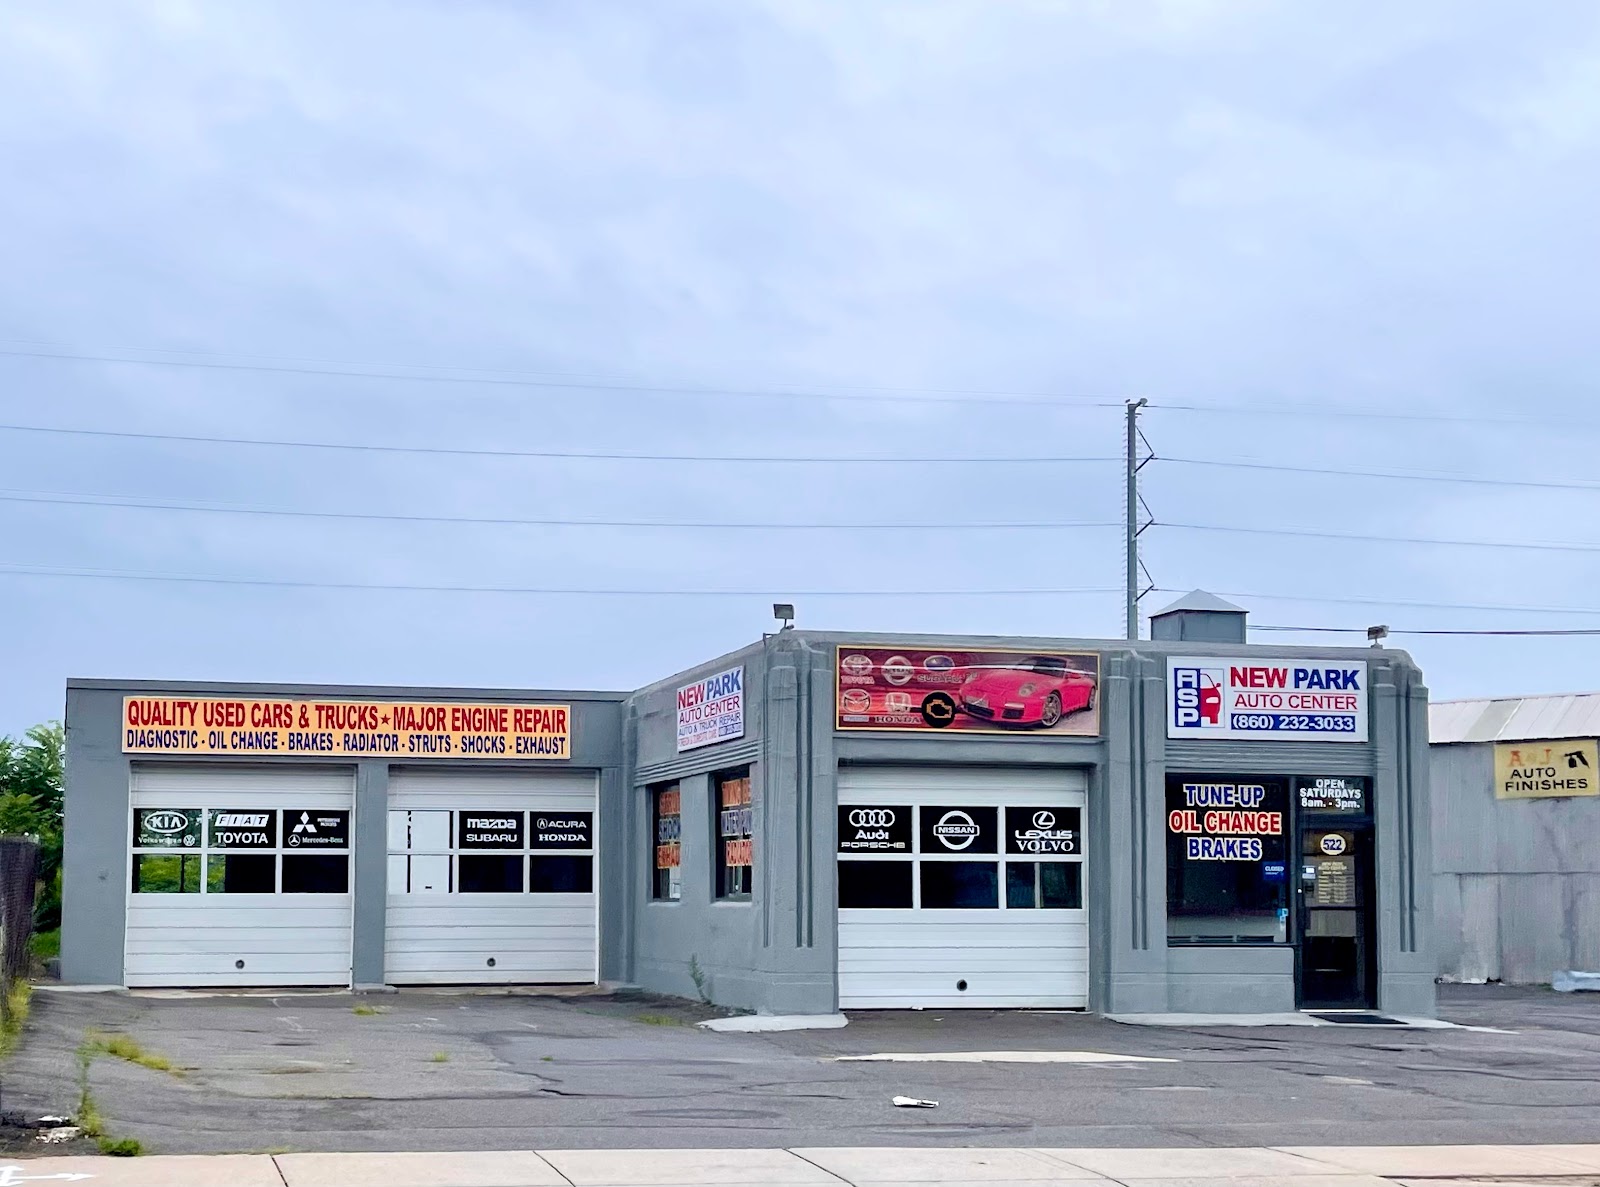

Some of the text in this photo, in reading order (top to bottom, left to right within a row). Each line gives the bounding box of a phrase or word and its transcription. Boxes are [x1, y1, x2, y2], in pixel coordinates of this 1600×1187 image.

[1230, 666, 1361, 690] NEW PARK
[678, 670, 741, 709] NEW PARK
[1234, 693, 1357, 710] AUTO CENTER
[680, 696, 740, 724] AUTO CENTER
[128, 700, 567, 734] QUALITY USED CARS & TRUCKS MAJOR ENGINE REPAIR
[719, 712, 741, 725] REPAIR
[1233, 714, 1354, 731] (860) 232-3033
[127, 729, 565, 755] DIAGNOSTIC OIL CHANGE BRAKES RADIATOR STRUTS SHOCKS EXHAUST
[1510, 767, 1556, 779] AUTO
[1316, 779, 1345, 788] OPEN
[1505, 778, 1588, 792] FINISHES
[1183, 784, 1265, 807] TUNE-UP
[1300, 787, 1361, 799] SATURDAYS
[149, 816, 182, 828] KIA
[217, 815, 268, 825] FIAT
[548, 820, 587, 829] ACURA
[1169, 810, 1282, 835] OIL CHANGE
[855, 829, 889, 840] Audi
[938, 826, 975, 834] NISSAN
[1015, 829, 1073, 839] LEXUS
[215, 832, 269, 844] TOYOTA
[466, 833, 517, 842] SUBARU
[538, 834, 586, 842] HONDA
[841, 841, 905, 849] PORSCHE
[1016, 840, 1074, 851] VOLVO
[1187, 837, 1263, 861] BRAKES
[1323, 839, 1343, 851] 522
